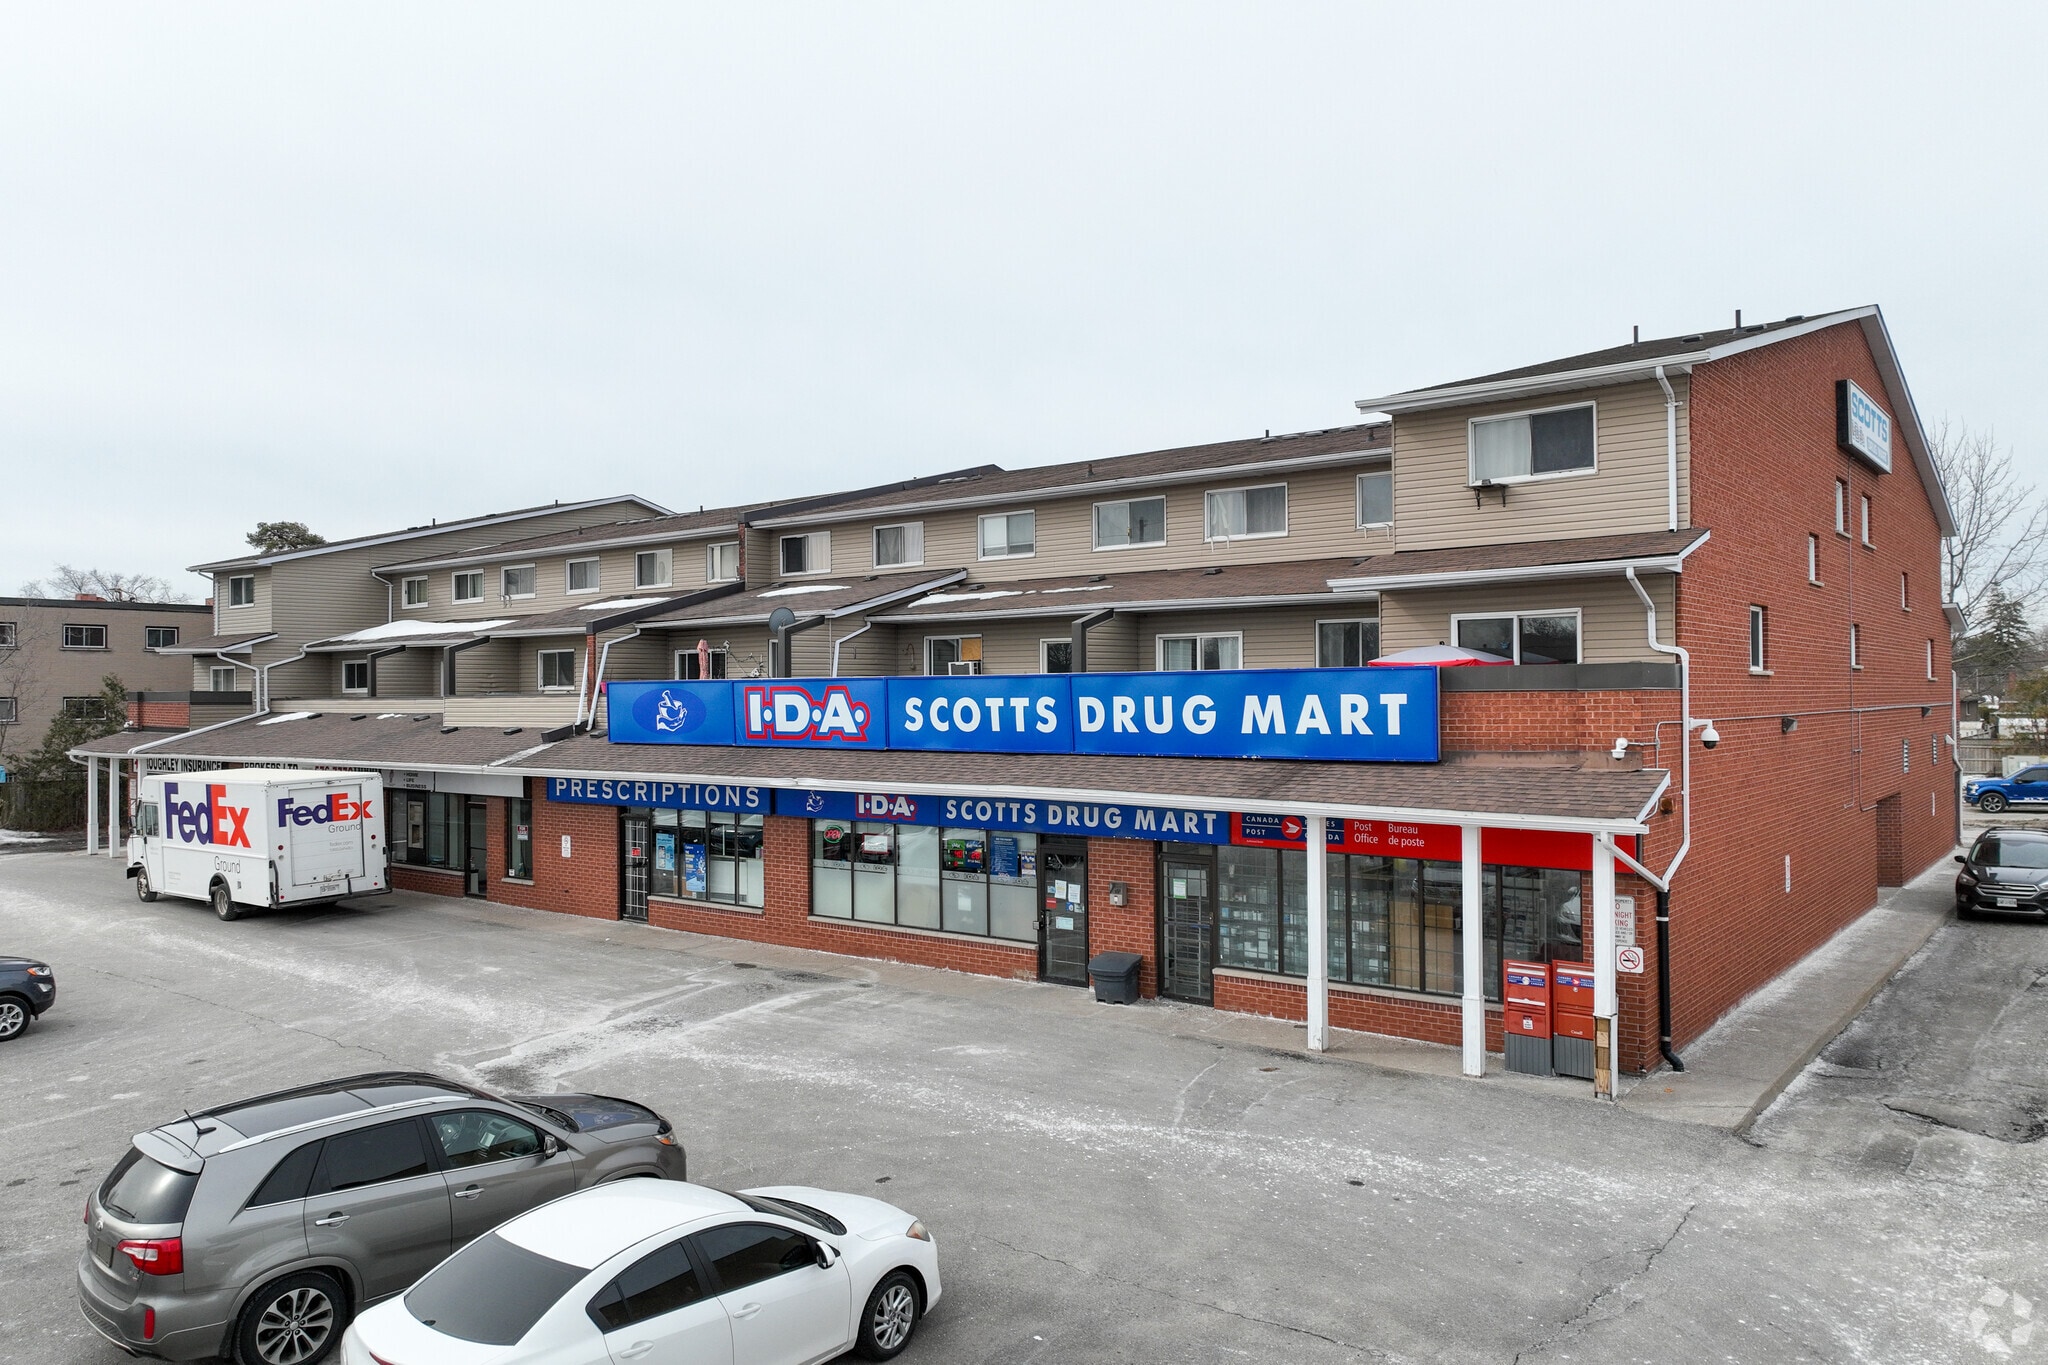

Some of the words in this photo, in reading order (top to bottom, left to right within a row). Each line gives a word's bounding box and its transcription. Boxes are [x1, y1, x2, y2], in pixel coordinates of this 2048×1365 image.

[1851, 392, 1888, 443] SCOTTS
[904, 696, 1058, 733] SCOTTS
[1078, 694, 1217, 735] DRUG
[1241, 693, 1408, 736] MART
[556, 778, 760, 808] PRESCRIPTIONS
[164, 782, 251, 849] FedEx
[277, 793, 373, 827] FedEx
[946, 798, 1037, 824] SCOTTS
[1048, 804, 1122, 829] DRUG
[1134, 808, 1218, 835] MART
[1246, 815, 1280, 824] CANADA
[1353, 821, 1373, 832] Post
[328, 823, 361, 834] Ground
[1246, 828, 1266, 836] POST
[1388, 823, 1418, 835] Bureau
[1353, 832, 1379, 844] Office
[1388, 834, 1399, 845] de
[1401, 836, 1425, 848] poste
[214, 855, 241, 874] Ground
[1615, 911, 1632, 919] NIGHT
